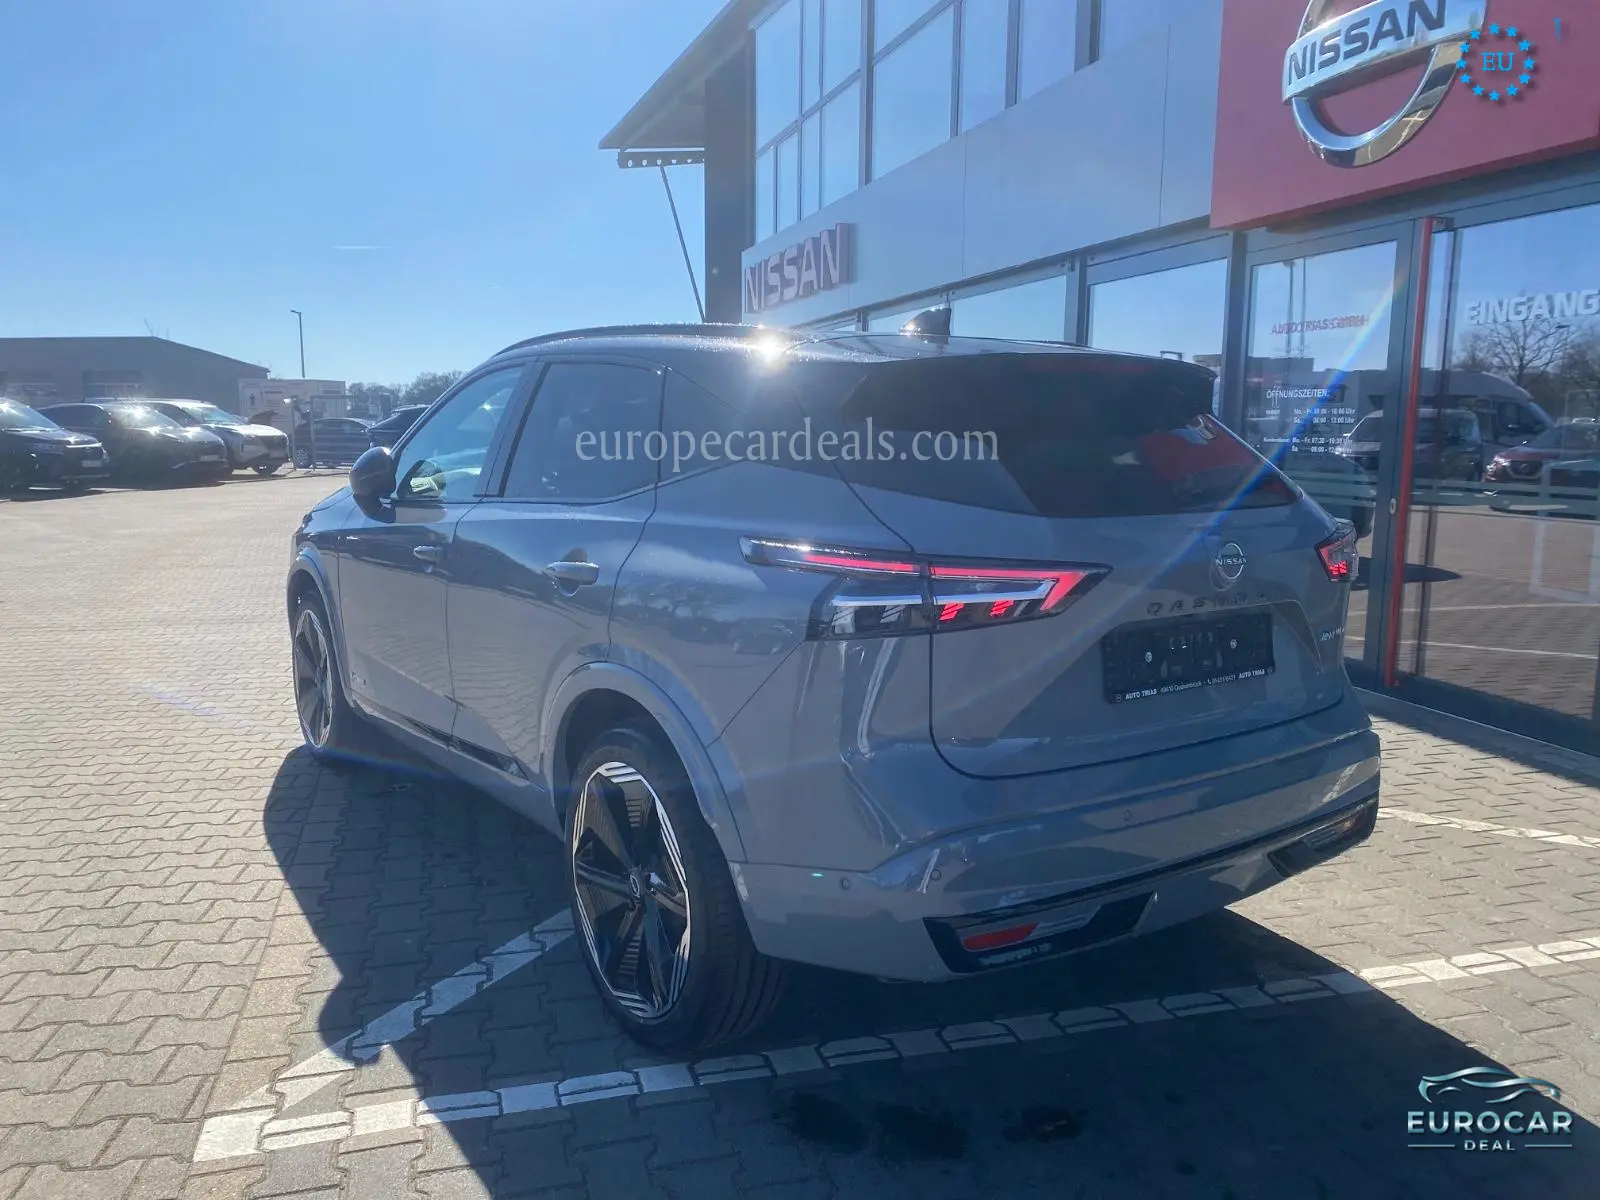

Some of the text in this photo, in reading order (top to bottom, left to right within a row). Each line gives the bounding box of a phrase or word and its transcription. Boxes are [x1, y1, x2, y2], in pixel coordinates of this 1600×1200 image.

[1288, 0, 1446, 86] NISSAN
[743, 223, 852, 314] NISSAN
[1466, 289, 1600, 325] EINGANG
[1215, 557, 1247, 567] NISSAN
[1125, 691, 1140, 700] AUTO
[1141, 688, 1157, 697] TRIAS
[1238, 671, 1251, 680] AUTO
